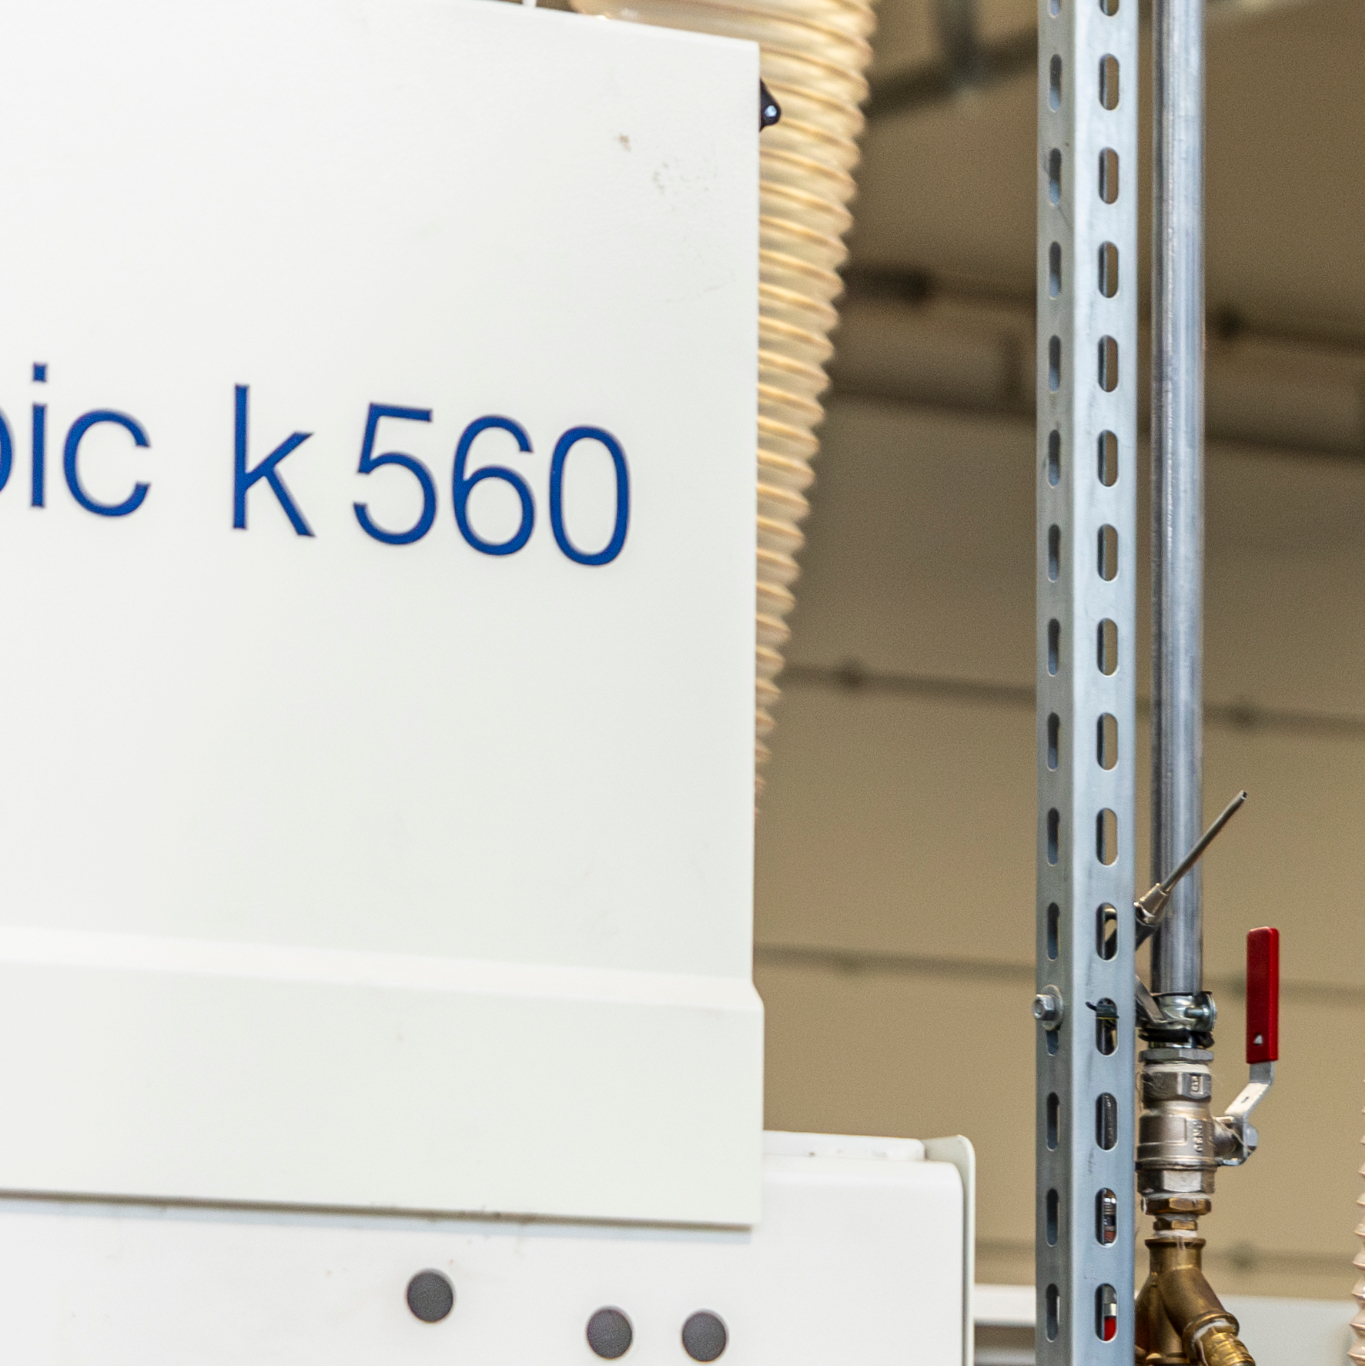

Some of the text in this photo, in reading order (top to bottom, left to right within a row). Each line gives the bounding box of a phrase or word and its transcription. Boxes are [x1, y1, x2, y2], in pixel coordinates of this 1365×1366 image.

[0, 362, 631, 567] ic k 560
